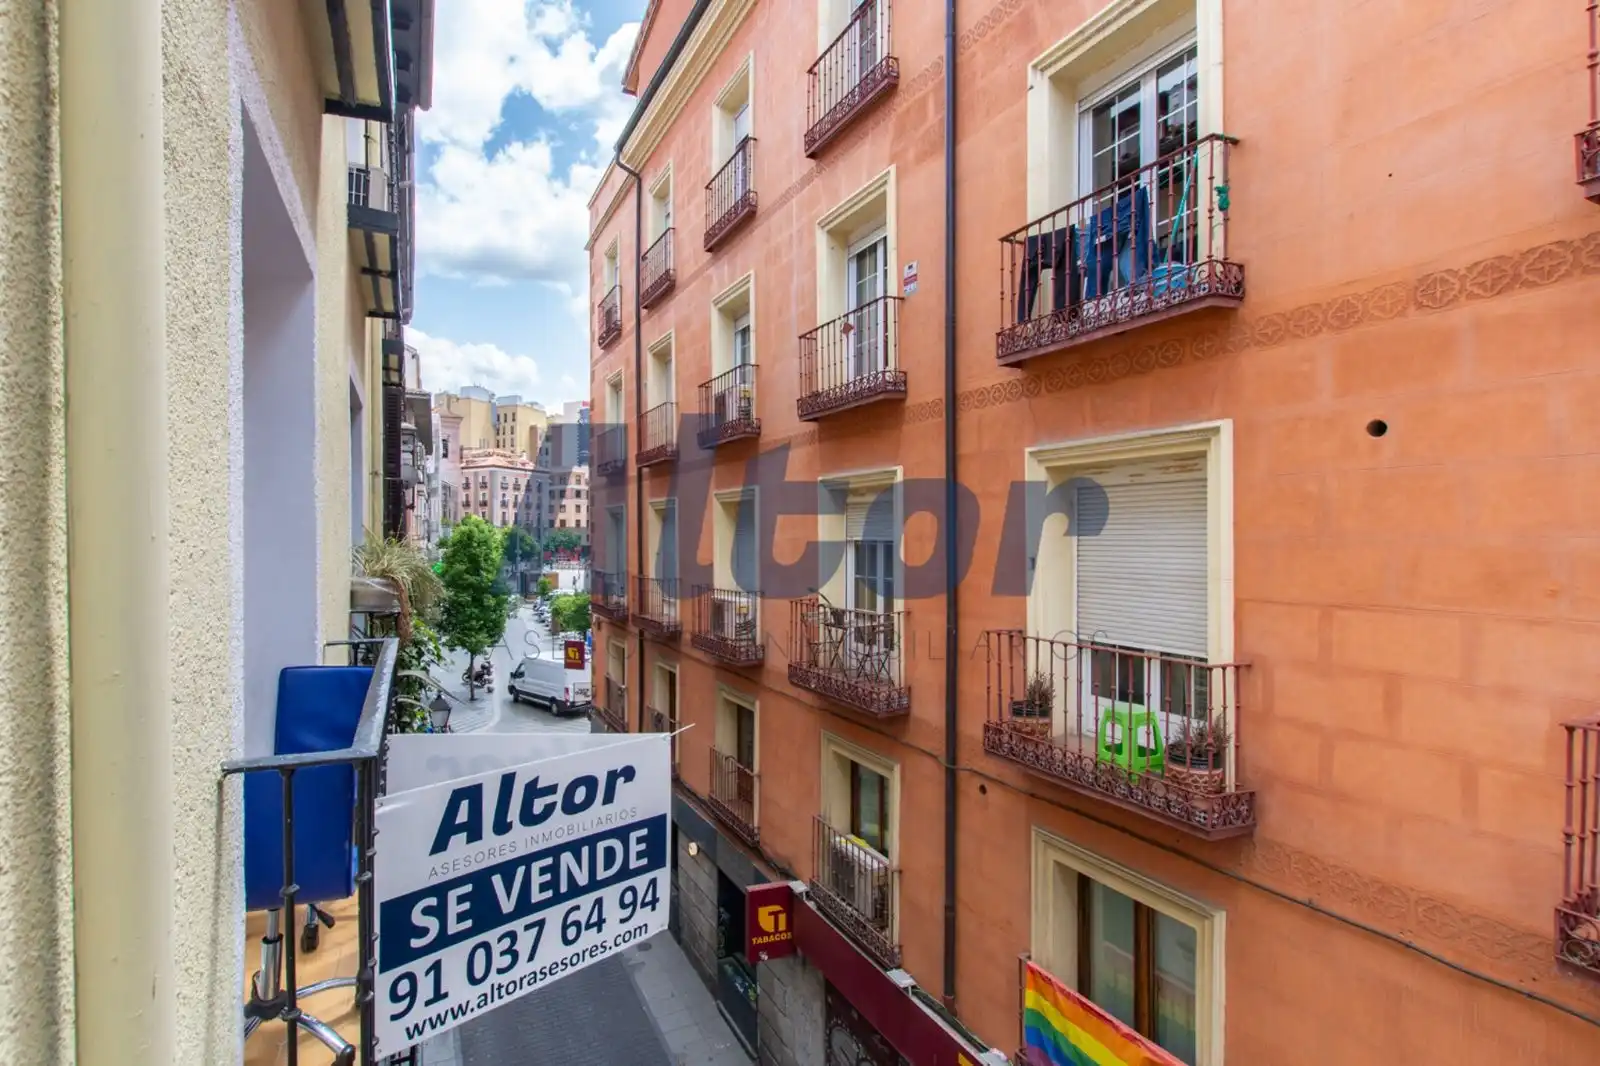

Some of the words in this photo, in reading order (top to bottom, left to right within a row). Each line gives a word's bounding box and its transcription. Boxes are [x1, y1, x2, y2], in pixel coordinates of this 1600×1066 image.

[428, 764, 636, 856] Altor
[428, 841, 517, 880] ASESORES
[524, 807, 637, 849] INMOBILIARIOS
[409, 883, 473, 949] SE
[490, 828, 649, 915] VENDE
[752, 932, 793, 945] TABACOS
[389, 958, 449, 1022] 91
[466, 917, 547, 987] 037
[560, 896, 606, 946] 64
[618, 877, 660, 924] 94
[405, 923, 648, 1041] www.altorasesores.com
